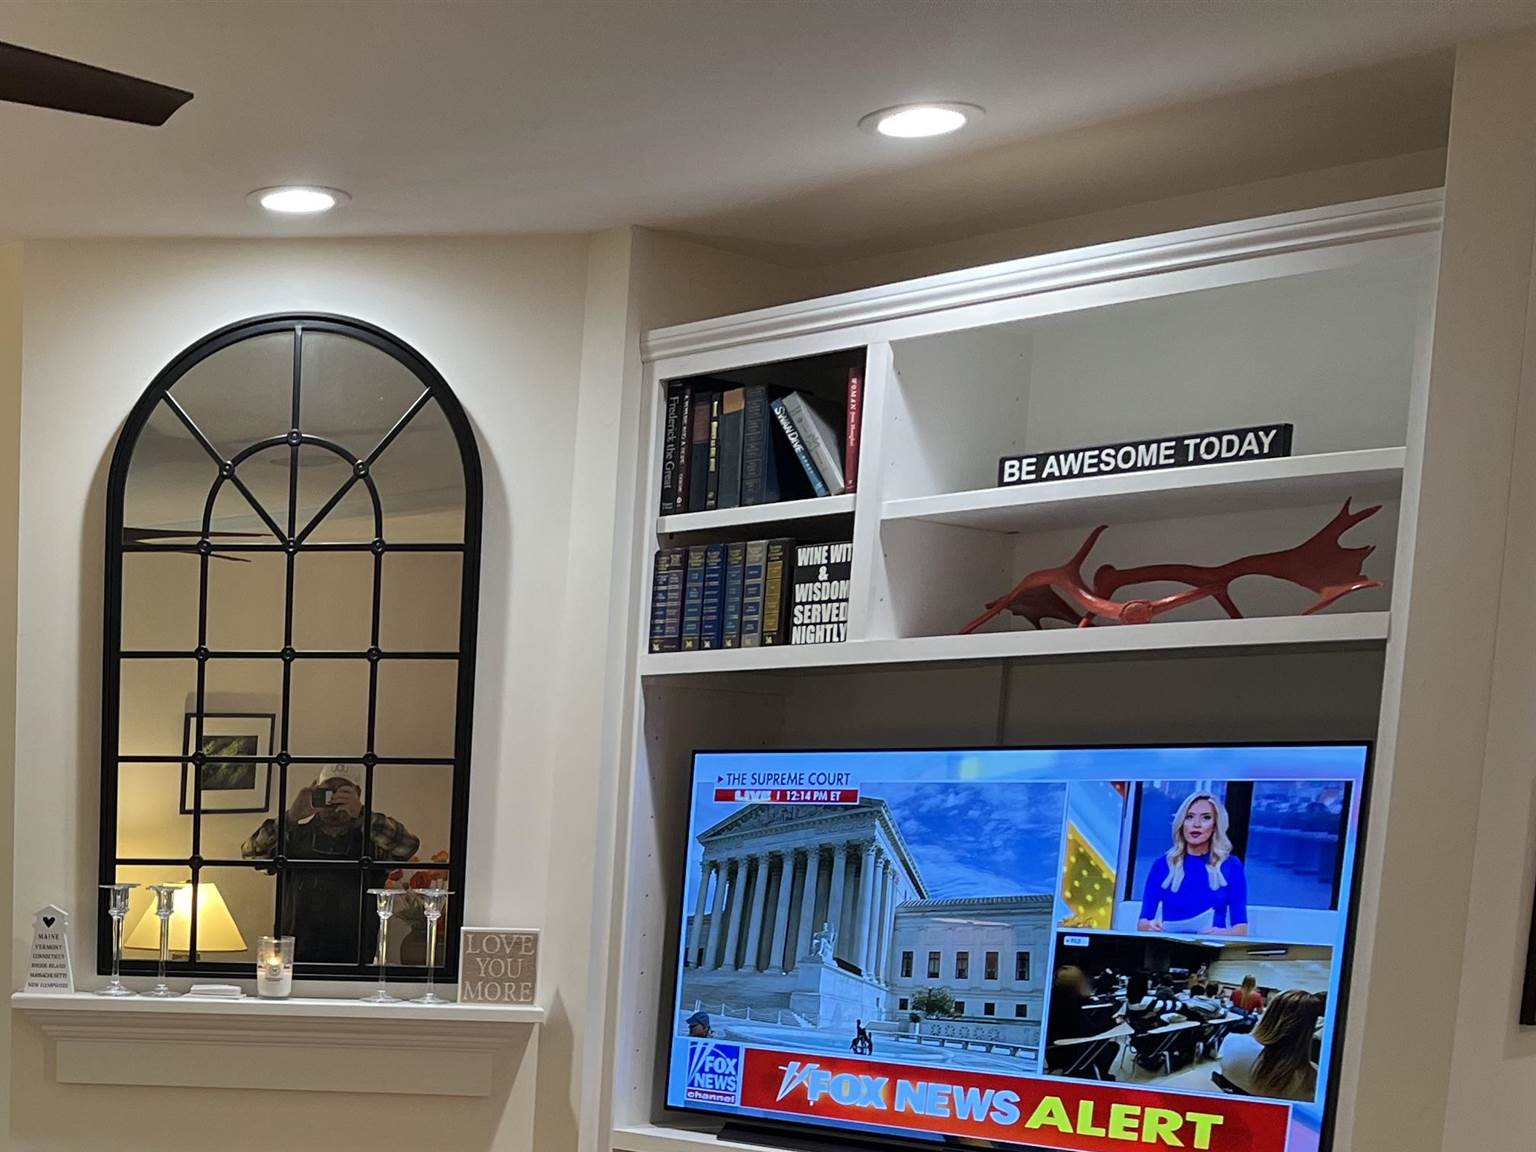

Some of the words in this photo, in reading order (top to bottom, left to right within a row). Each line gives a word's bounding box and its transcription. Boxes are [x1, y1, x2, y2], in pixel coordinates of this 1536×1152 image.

[667, 396, 680, 443] Frederick
[775, 406, 795, 434] SWAN
[787, 431, 804, 452] DIVE
[665, 444, 676, 460] the
[1003, 458, 1037, 483] BE
[1041, 441, 1176, 479] AWESOME
[1183, 429, 1277, 462] TODAY
[663, 461, 675, 489] Great
[797, 545, 829, 567] WINE
[830, 543, 853, 563] WIT
[818, 565, 829, 581] &
[795, 580, 850, 603] WISDOM
[793, 602, 848, 625] SERVED
[791, 623, 847, 645] NIGHTLY
[726, 772, 747, 785] THE
[750, 772, 805, 786] SUPREME
[808, 772, 851, 786] COURT
[786, 790, 811, 801] 12:14
[813, 791, 828, 801] PM
[830, 791, 842, 801] ET
[465, 934, 535, 955] LOVE
[475, 957, 524, 978] YOU
[463, 981, 533, 1002] MORE
[704, 1054, 737, 1076] FOX
[693, 1072, 737, 1093] NEWS
[686, 1091, 736, 1104] channel
[807, 1069, 889, 1109] FOX
[894, 1079, 1021, 1126] NEWS
[1024, 1095, 1224, 1151] ALERT
